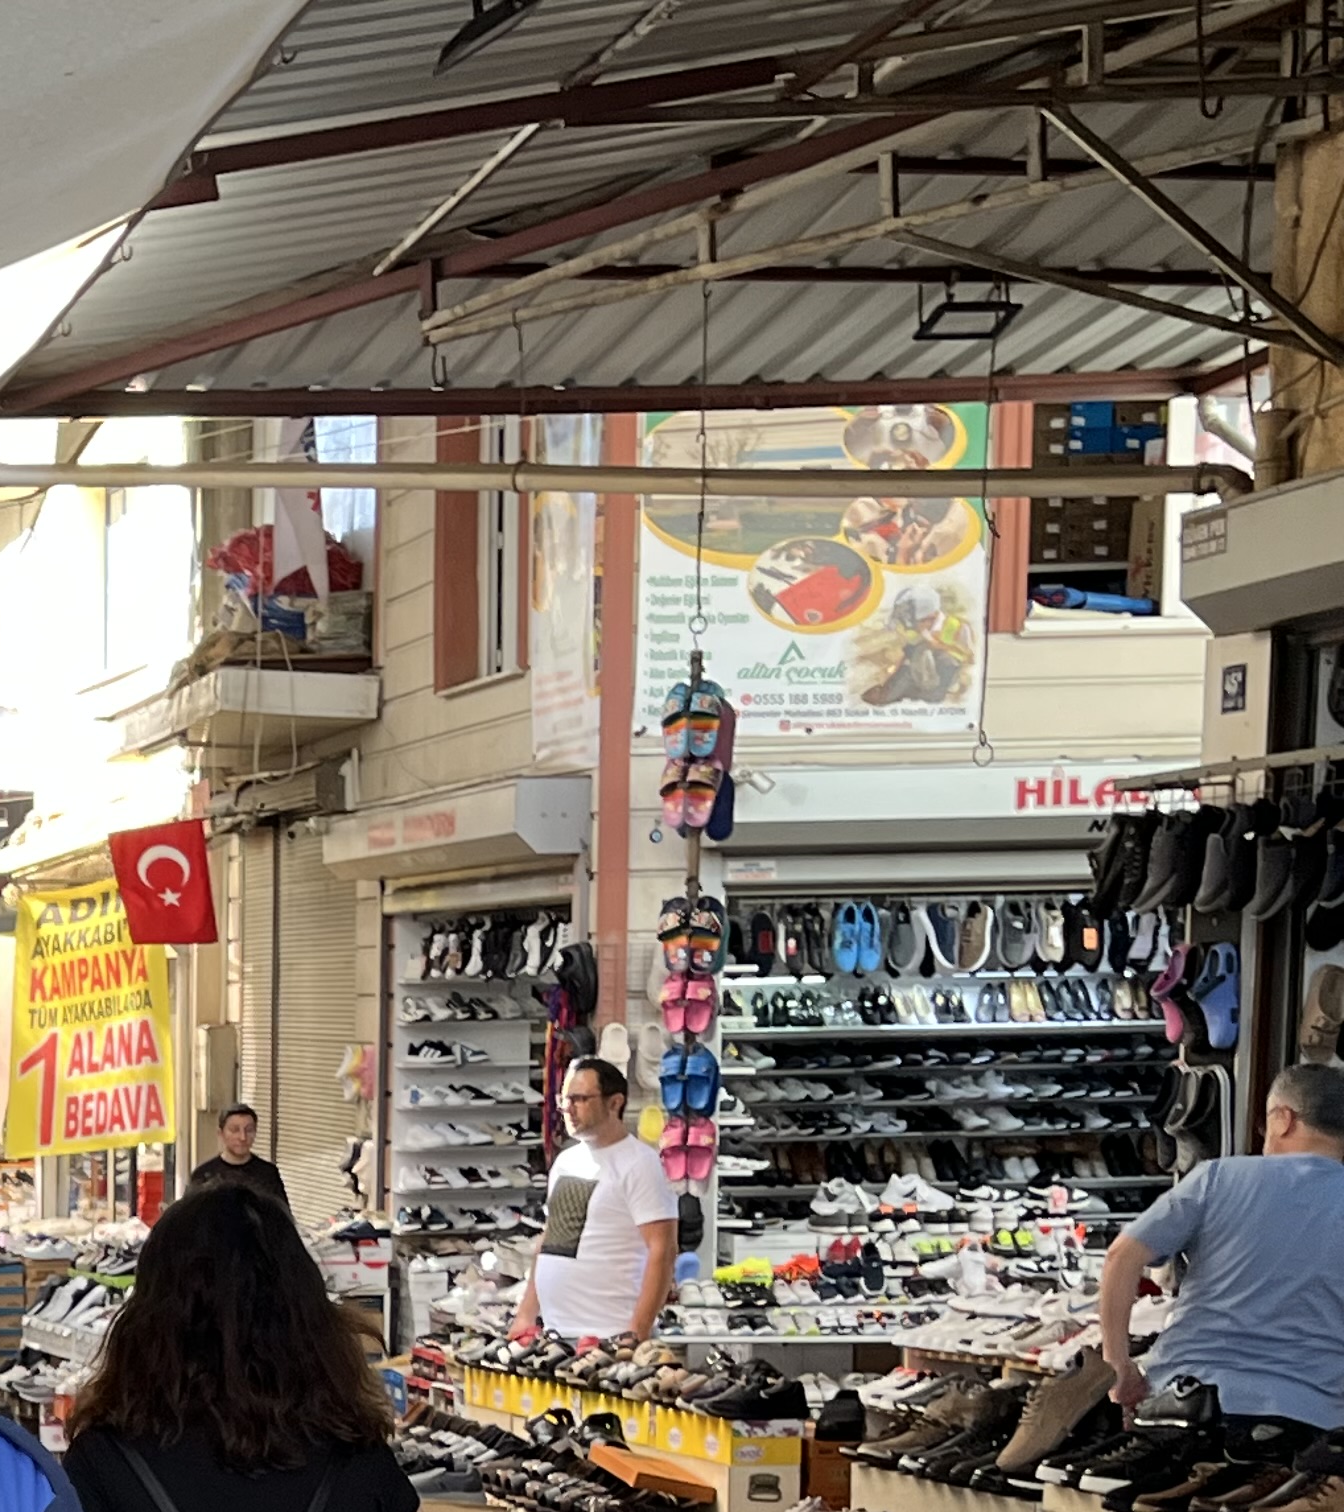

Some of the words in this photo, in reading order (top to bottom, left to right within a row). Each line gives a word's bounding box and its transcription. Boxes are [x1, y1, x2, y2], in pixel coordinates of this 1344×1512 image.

[30, 917, 128, 961] AYAKKABI
[28, 945, 150, 1004] KAMPANYA
[66, 1018, 161, 1079] ALANA
[18, 1031, 59, 1147] 1
[63, 1081, 166, 1142] BEDAVA
